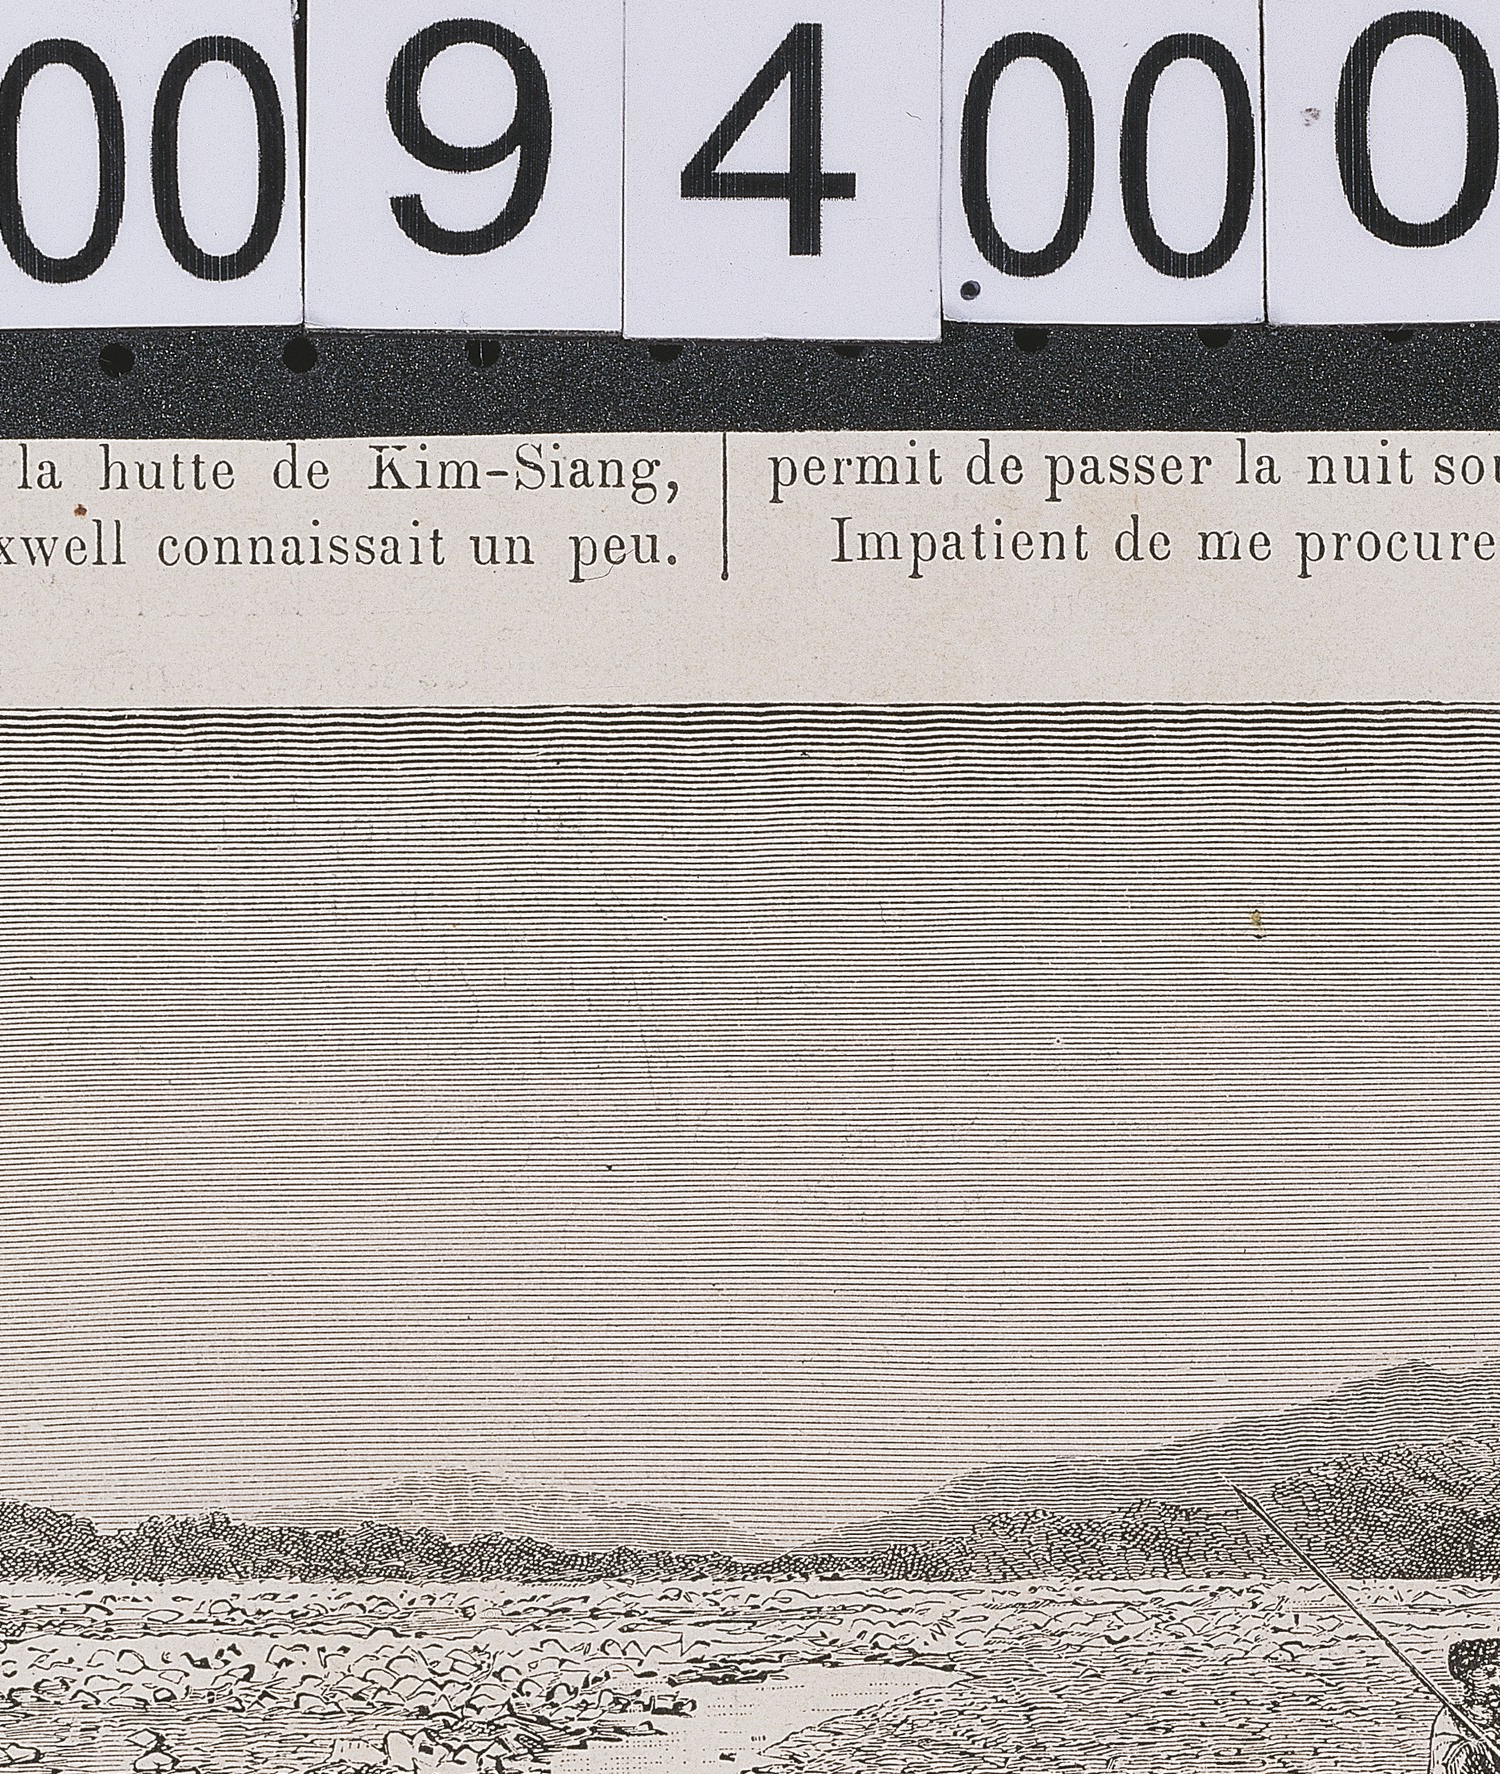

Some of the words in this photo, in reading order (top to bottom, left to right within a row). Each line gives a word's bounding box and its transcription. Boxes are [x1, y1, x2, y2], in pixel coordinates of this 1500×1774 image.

[17, 443, 63, 490] la
[98, 443, 235, 491] hutte
[273, 442, 330, 490] de
[367, 442, 679, 505] Kim-Siang,
[767, 439, 943, 504] permit
[966, 437, 1024, 486] de
[1044, 454, 1212, 503] passer
[1235, 437, 1282, 485] la
[1307, 439, 1414, 485] nuit
[158, 519, 445, 567] connaissait
[469, 535, 535, 566] un
[568, 534, 677, 584] peu.
[830, 516, 1089, 580] Impatient
[1114, 513, 1171, 562] de
[1197, 530, 1272, 562] me
